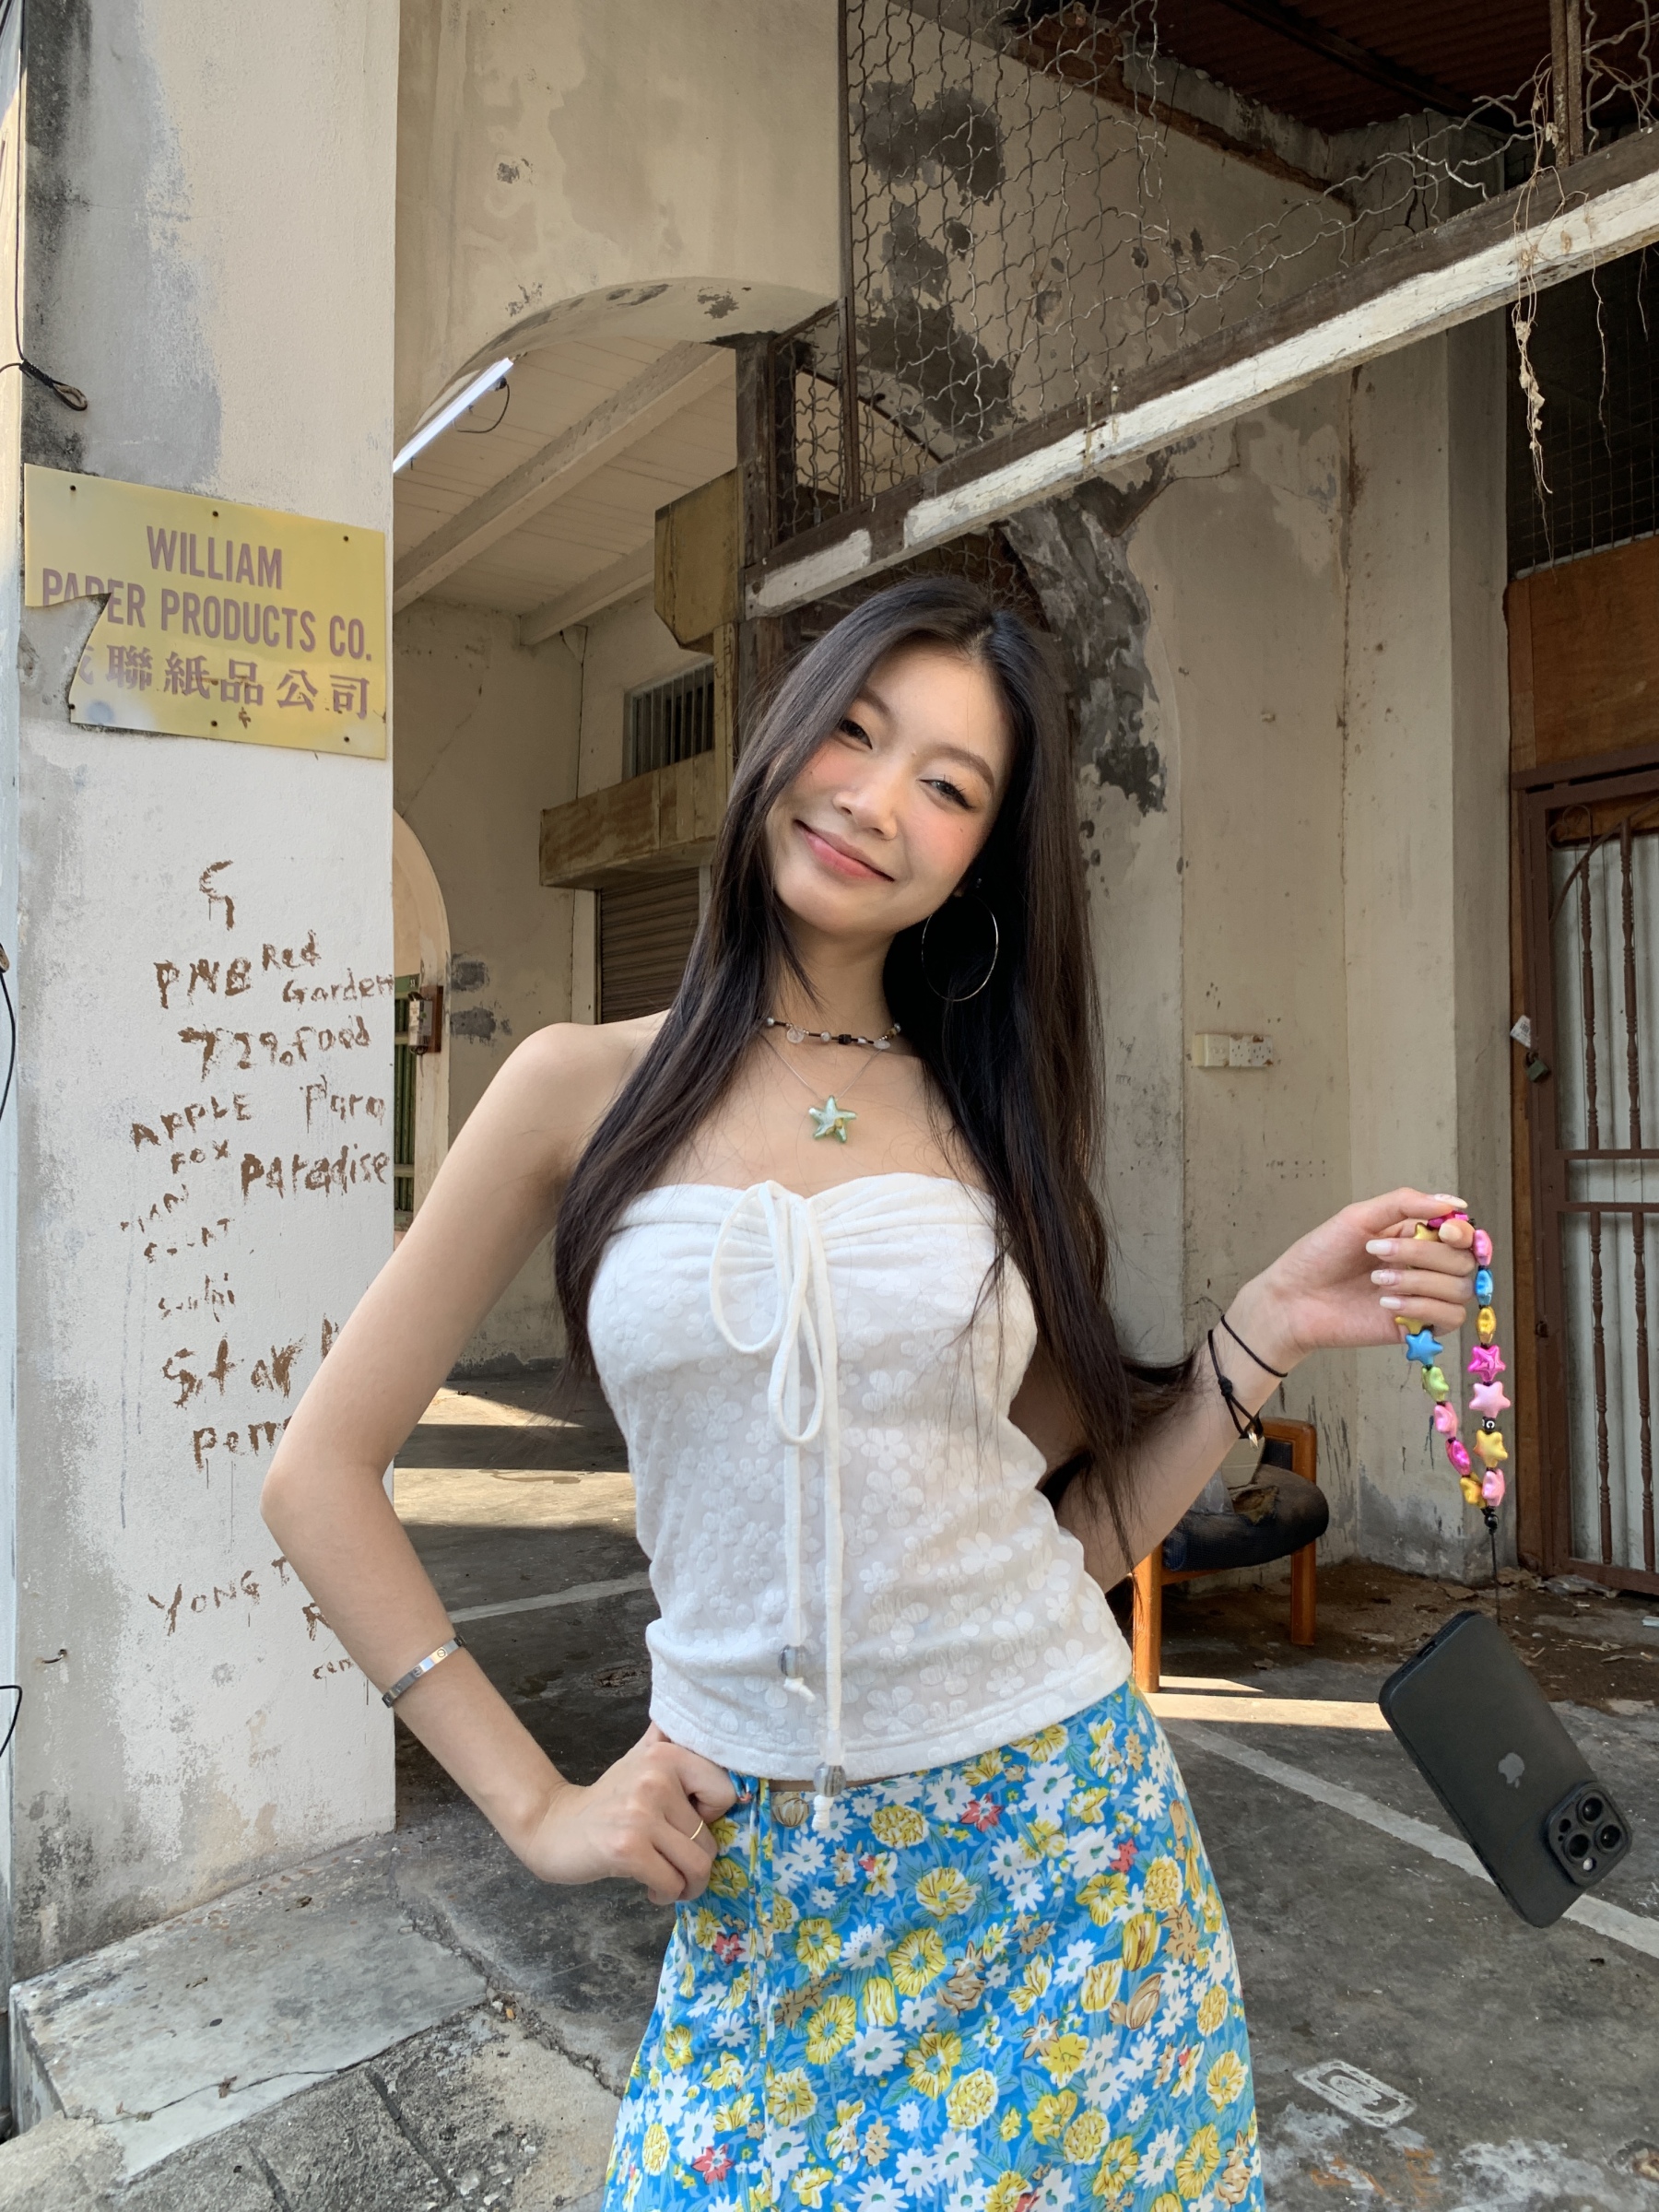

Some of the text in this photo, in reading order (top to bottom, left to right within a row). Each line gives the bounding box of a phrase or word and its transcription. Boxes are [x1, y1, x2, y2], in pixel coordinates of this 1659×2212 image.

[147, 525, 283, 590] WILLIAM
[160, 588, 317, 653] PRODUCTS
[328, 614, 372, 662] CO.
